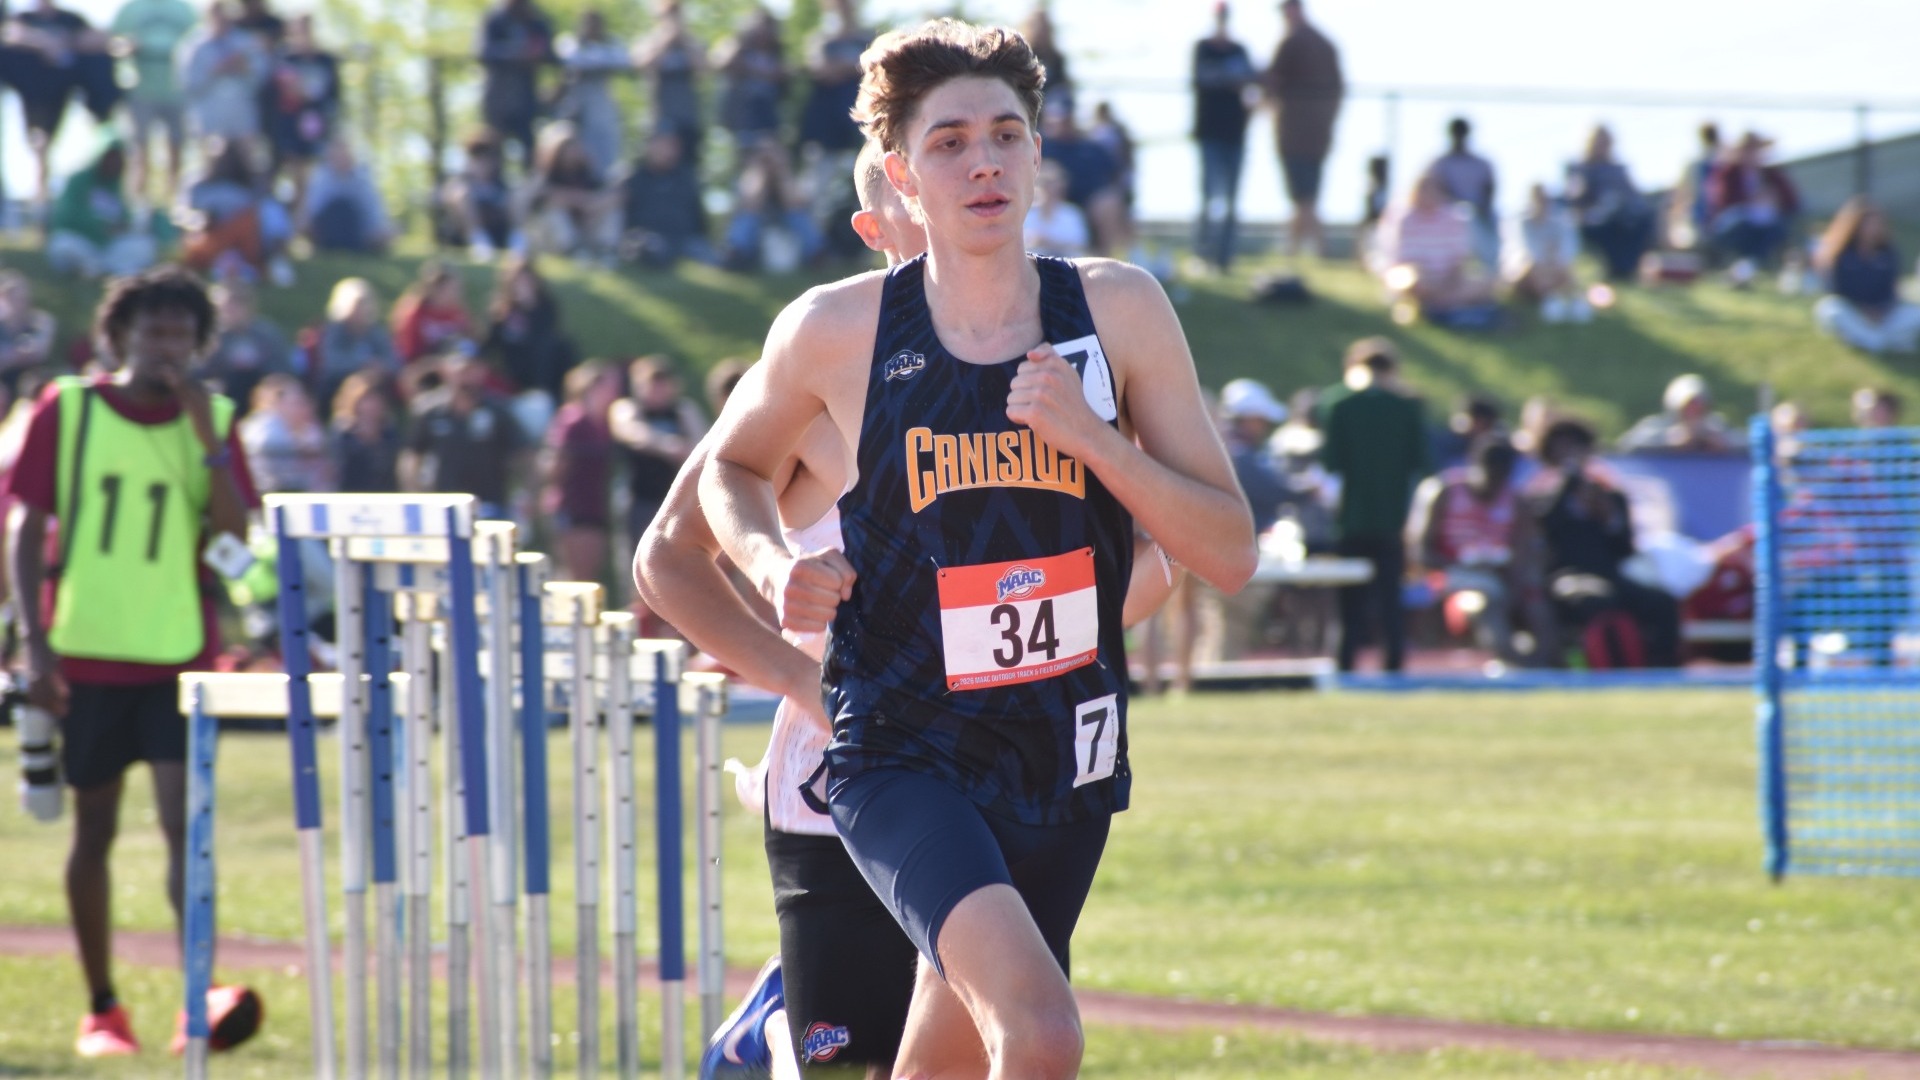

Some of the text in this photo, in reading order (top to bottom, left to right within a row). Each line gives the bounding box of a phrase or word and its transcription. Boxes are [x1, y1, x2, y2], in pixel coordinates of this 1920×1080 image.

[885, 353, 925, 381] MAAC
[99, 474, 168, 564] 11
[997, 570, 1044, 601] MAAC
[990, 599, 1059, 668] 34
[975, 674, 990, 684] MAAC
[991, 672, 1016, 682] OUTDOOR
[1017, 669, 1034, 679] TRACK
[1040, 665, 1053, 674] FIELD
[1082, 707, 1108, 774] 7
[804, 1026, 849, 1062] MAAC
